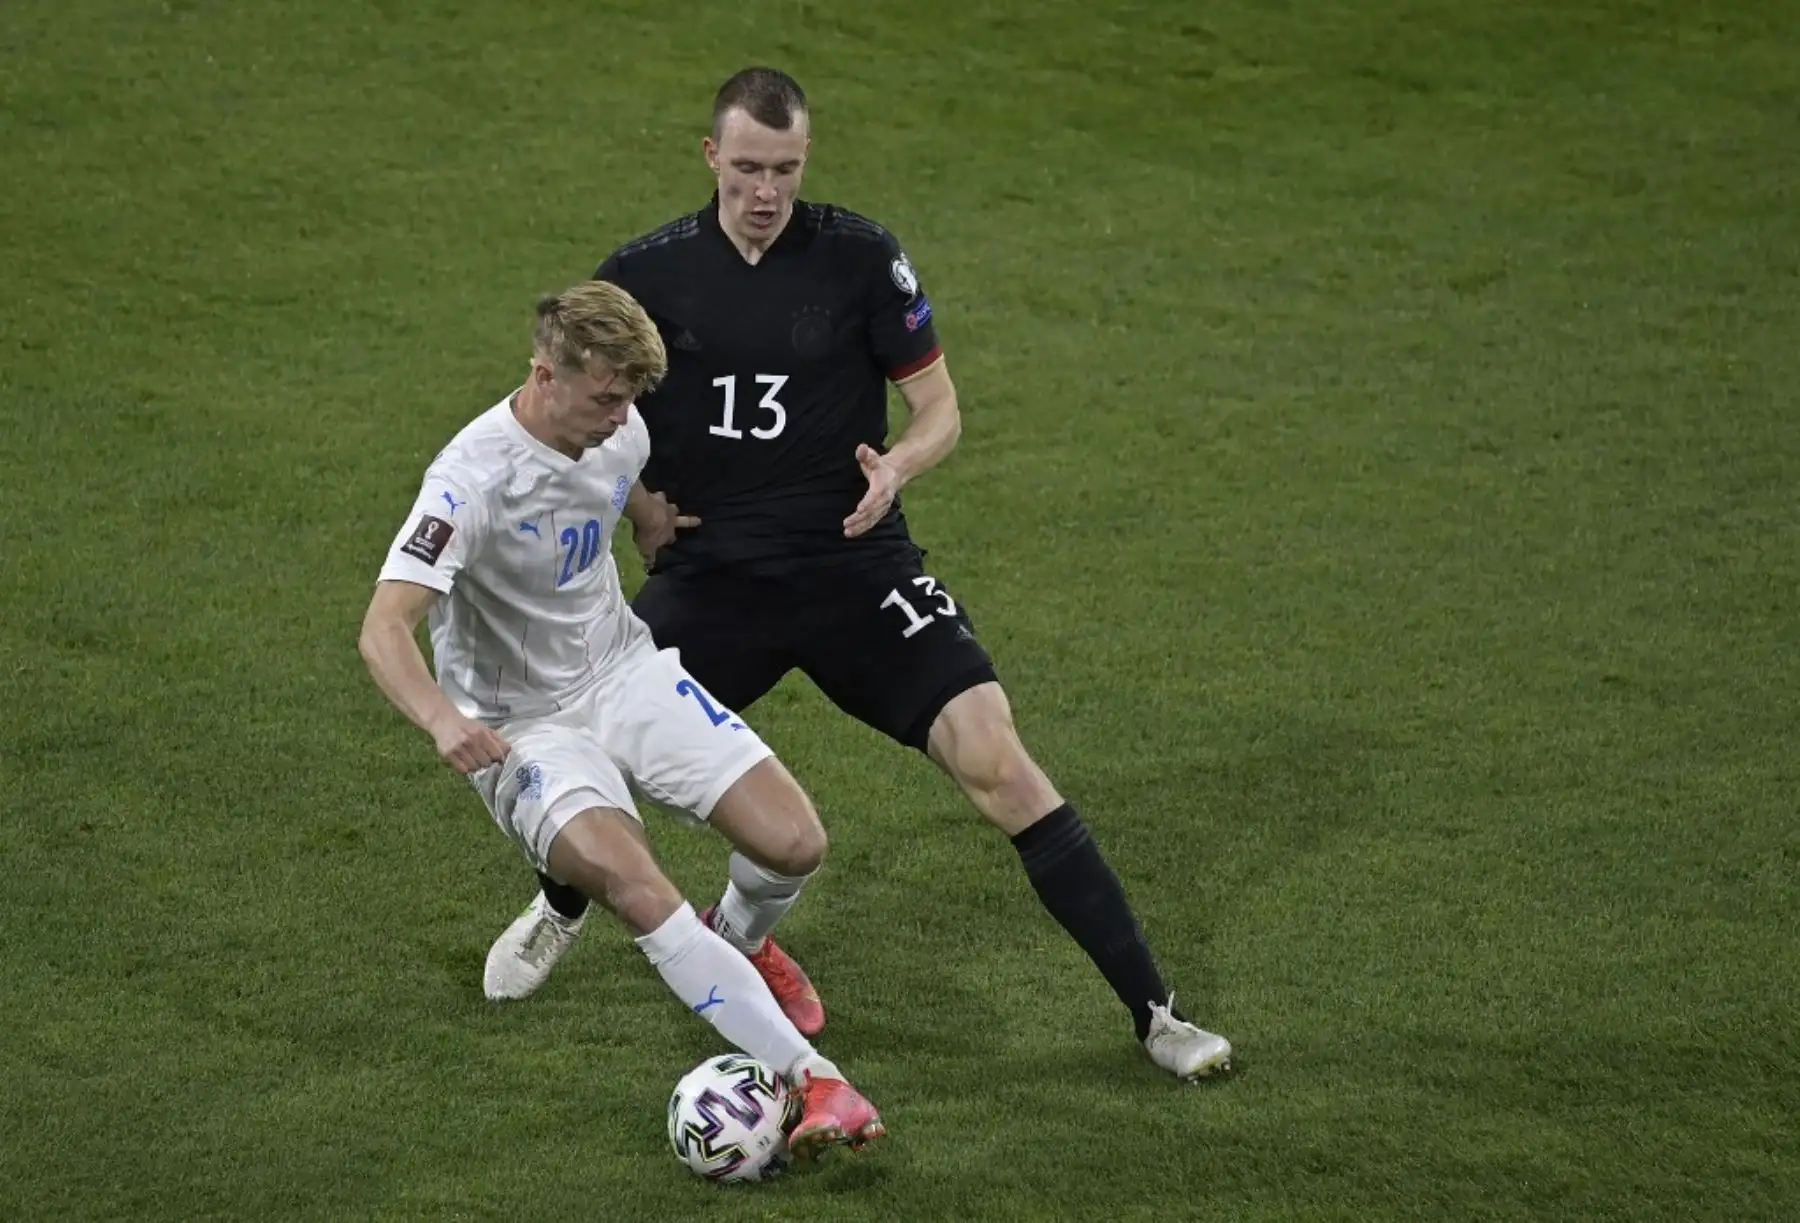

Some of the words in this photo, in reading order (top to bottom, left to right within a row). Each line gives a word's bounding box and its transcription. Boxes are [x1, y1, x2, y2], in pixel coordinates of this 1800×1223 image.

[708, 373, 790, 440] 13
[558, 518, 601, 587] 20
[879, 575, 957, 639] 13
[676, 679, 730, 727] 2
